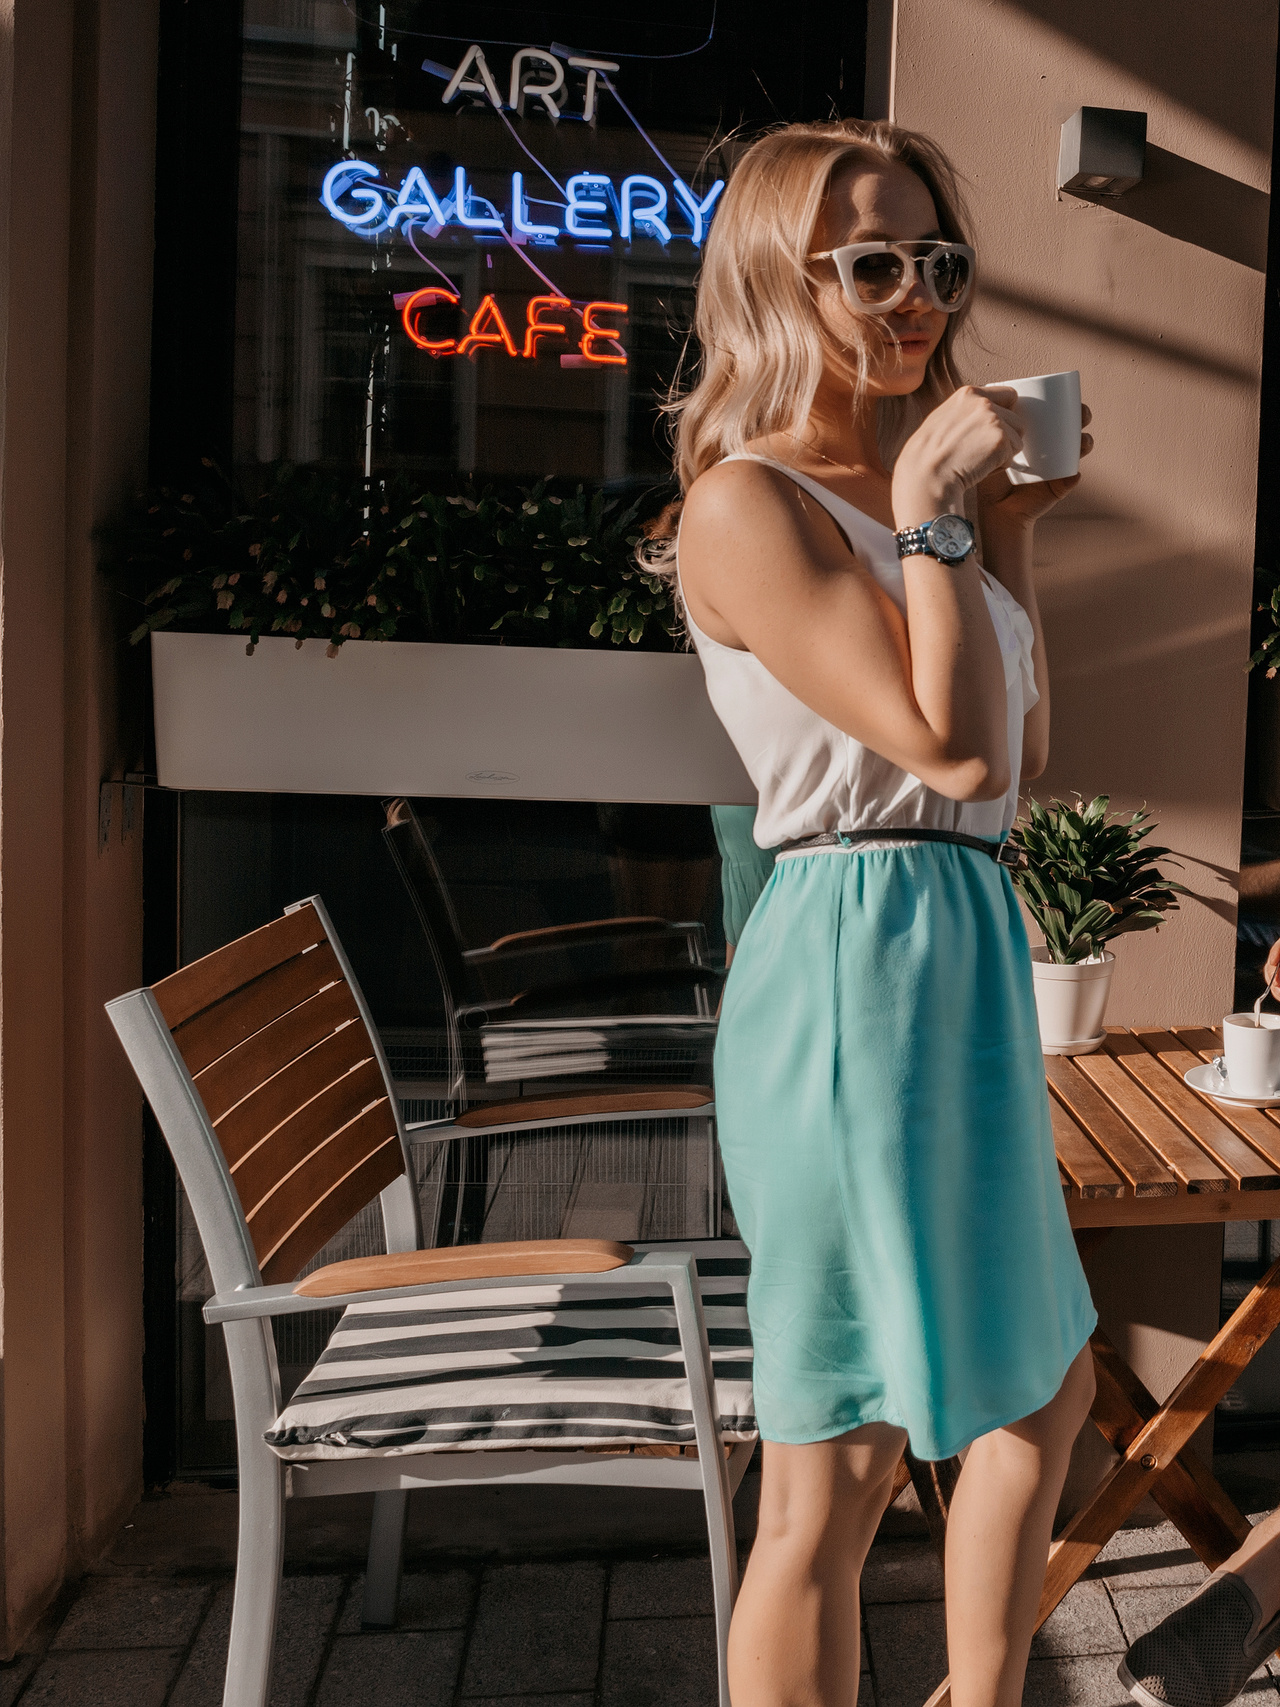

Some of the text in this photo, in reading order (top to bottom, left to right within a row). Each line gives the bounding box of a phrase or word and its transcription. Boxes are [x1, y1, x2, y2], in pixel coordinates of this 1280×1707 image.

[442, 44, 620, 121] ART
[322, 160, 725, 243] GALLERY
[402, 286, 628, 365] CAFE
